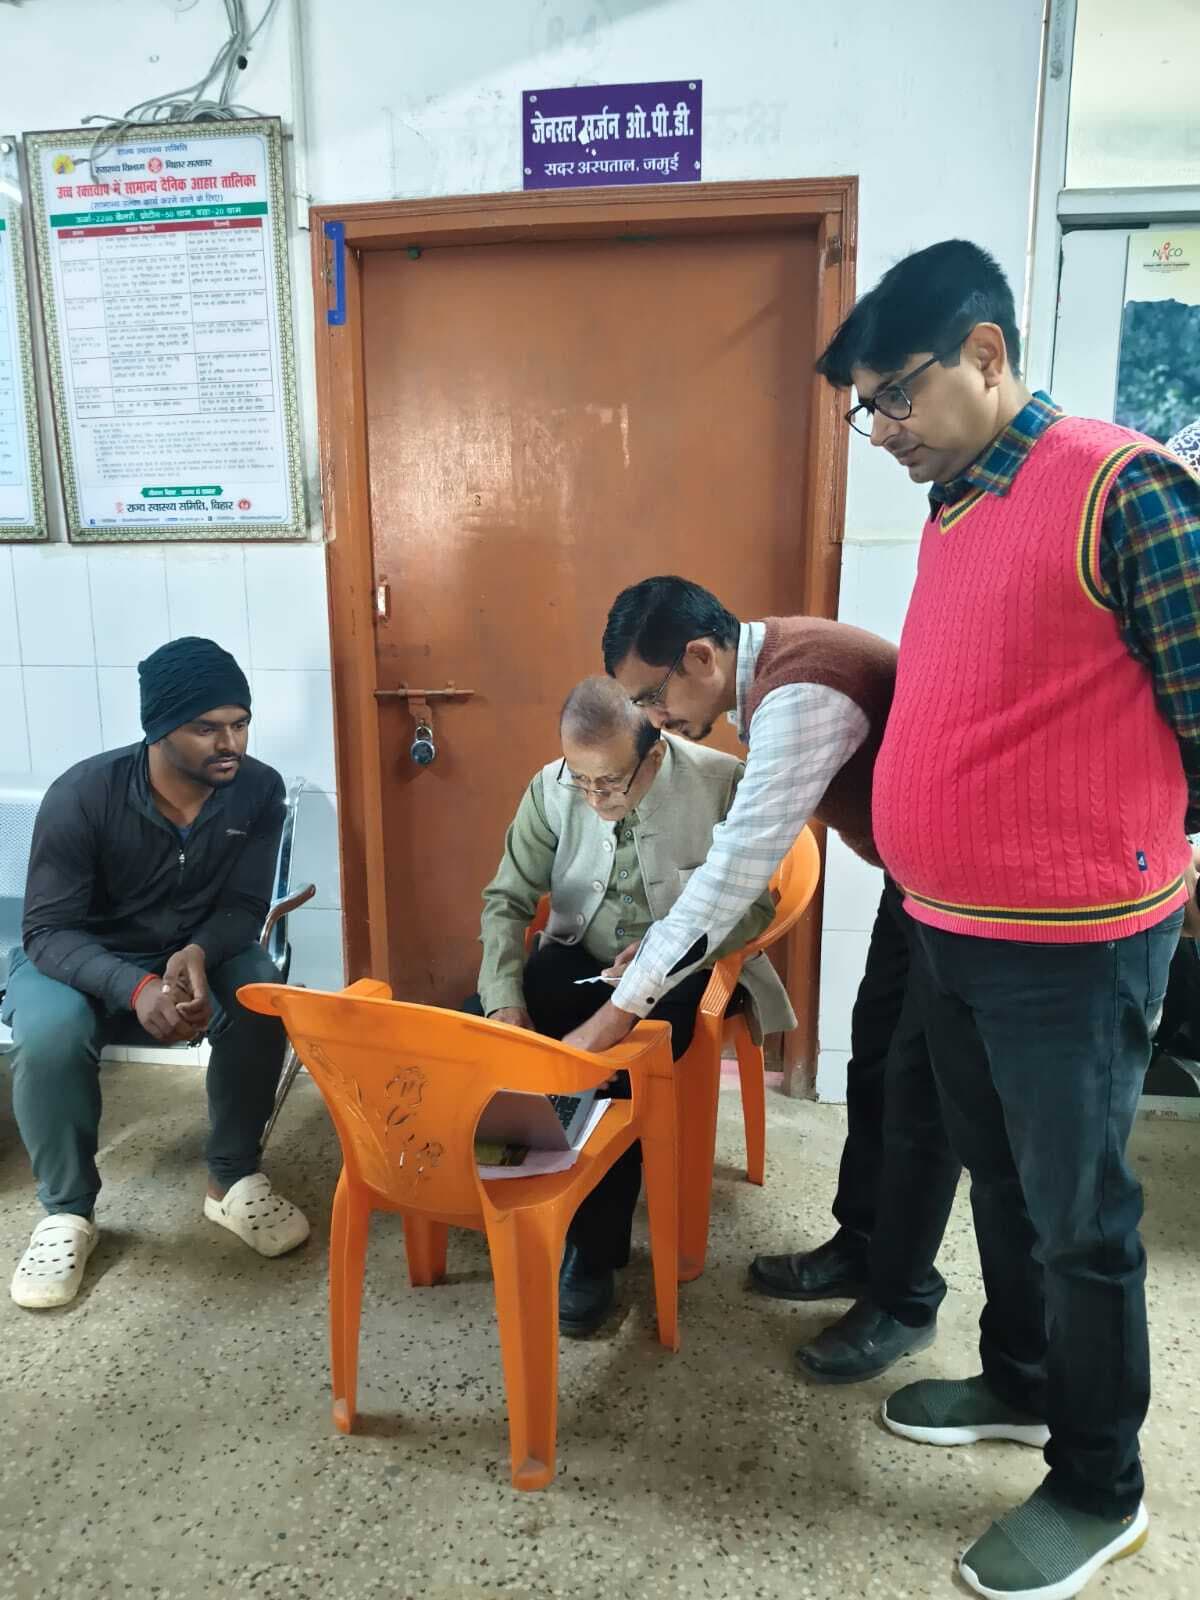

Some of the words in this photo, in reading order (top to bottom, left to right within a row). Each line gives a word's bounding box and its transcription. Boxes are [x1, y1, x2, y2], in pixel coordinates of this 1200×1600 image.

[530, 111, 578, 144] जेनरल
[578, 105, 620, 144] सर्जन
[626, 102, 694, 139] ओ.पी.डी.
[544, 162, 574, 176] सदर
[643, 152, 680, 175] जमुई
[124, 180, 158, 194] सामान्य
[191, 176, 217, 189] आहार
[221, 170, 256, 188] तालिका
[126, 502, 146, 513] राज्य
[147, 501, 177, 512] स्वास्थ्य
[210, 498, 234, 510] बिहार
